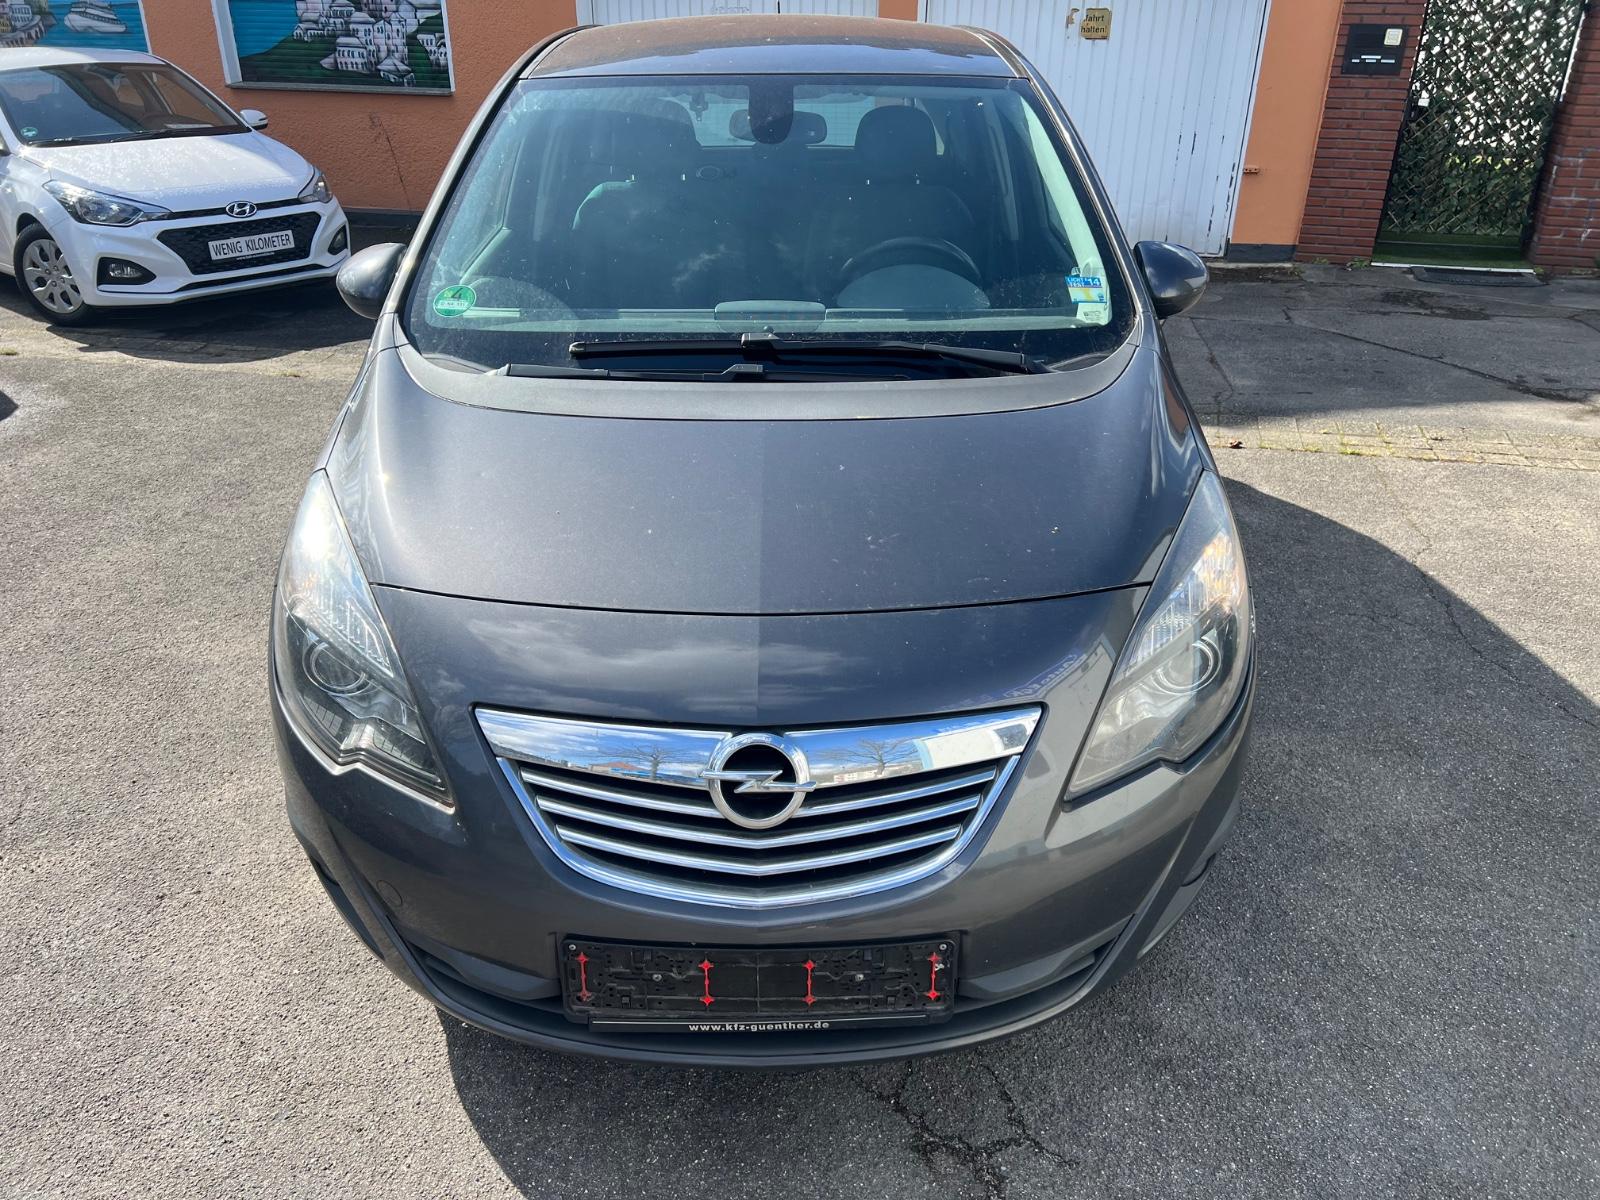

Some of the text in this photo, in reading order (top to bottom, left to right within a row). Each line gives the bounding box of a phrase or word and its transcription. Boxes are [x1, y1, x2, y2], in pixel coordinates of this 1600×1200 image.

[212, 241, 243, 257] WENIG
[244, 233, 292, 252] KILOMETER
[450, 287, 464, 301] 4
[688, 1021, 830, 1032] www.kfz-guenther.de
